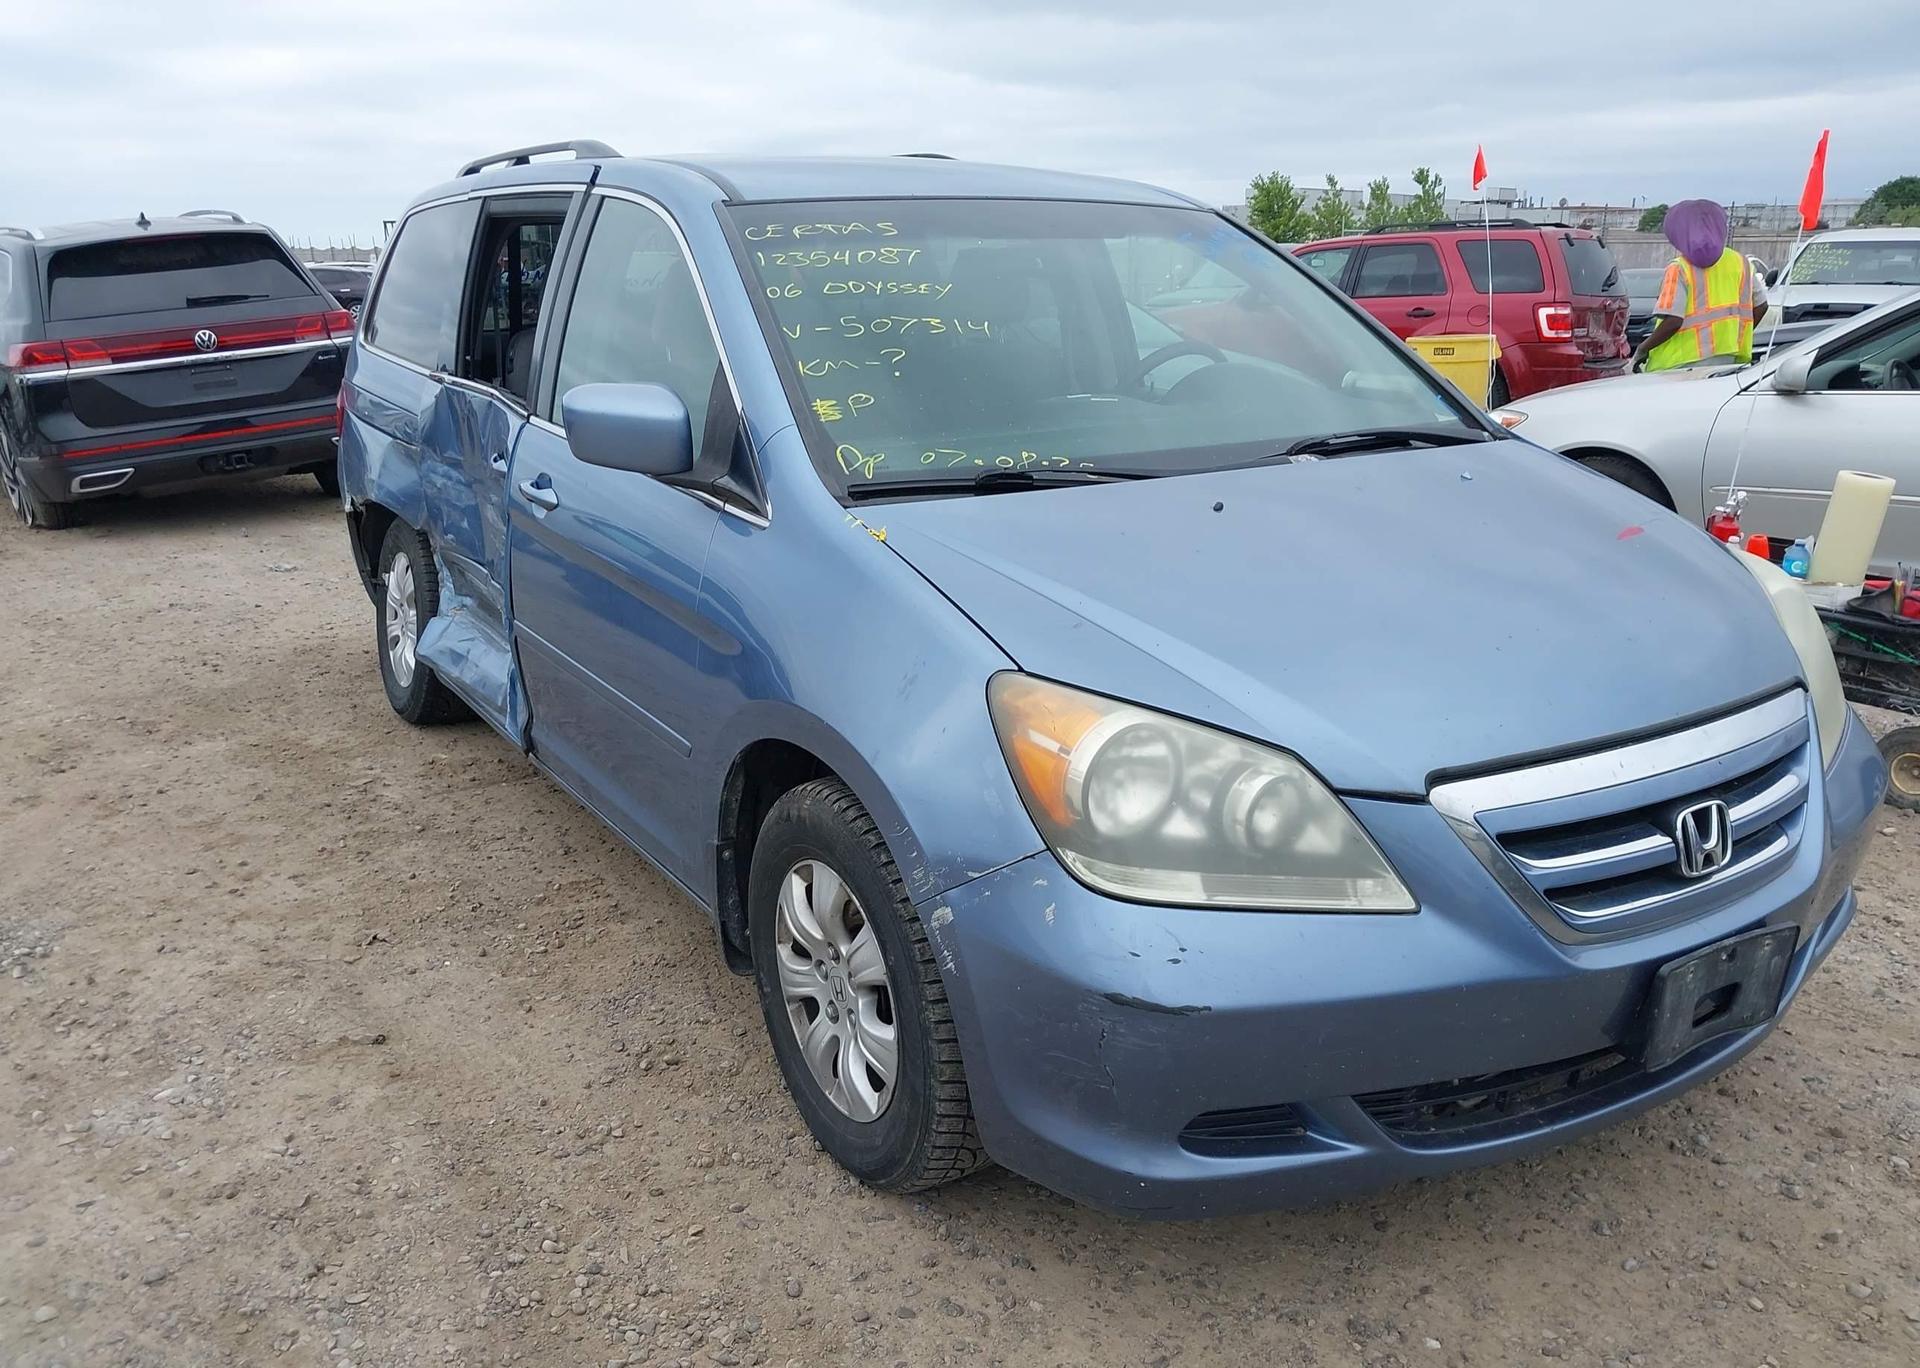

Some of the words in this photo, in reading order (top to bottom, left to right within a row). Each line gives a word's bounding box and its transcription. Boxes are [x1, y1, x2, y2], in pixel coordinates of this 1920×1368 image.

[756, 247, 921, 267] 12354087
[766, 282, 802, 299] 06
[823, 281, 953, 300] ODYSSEY
